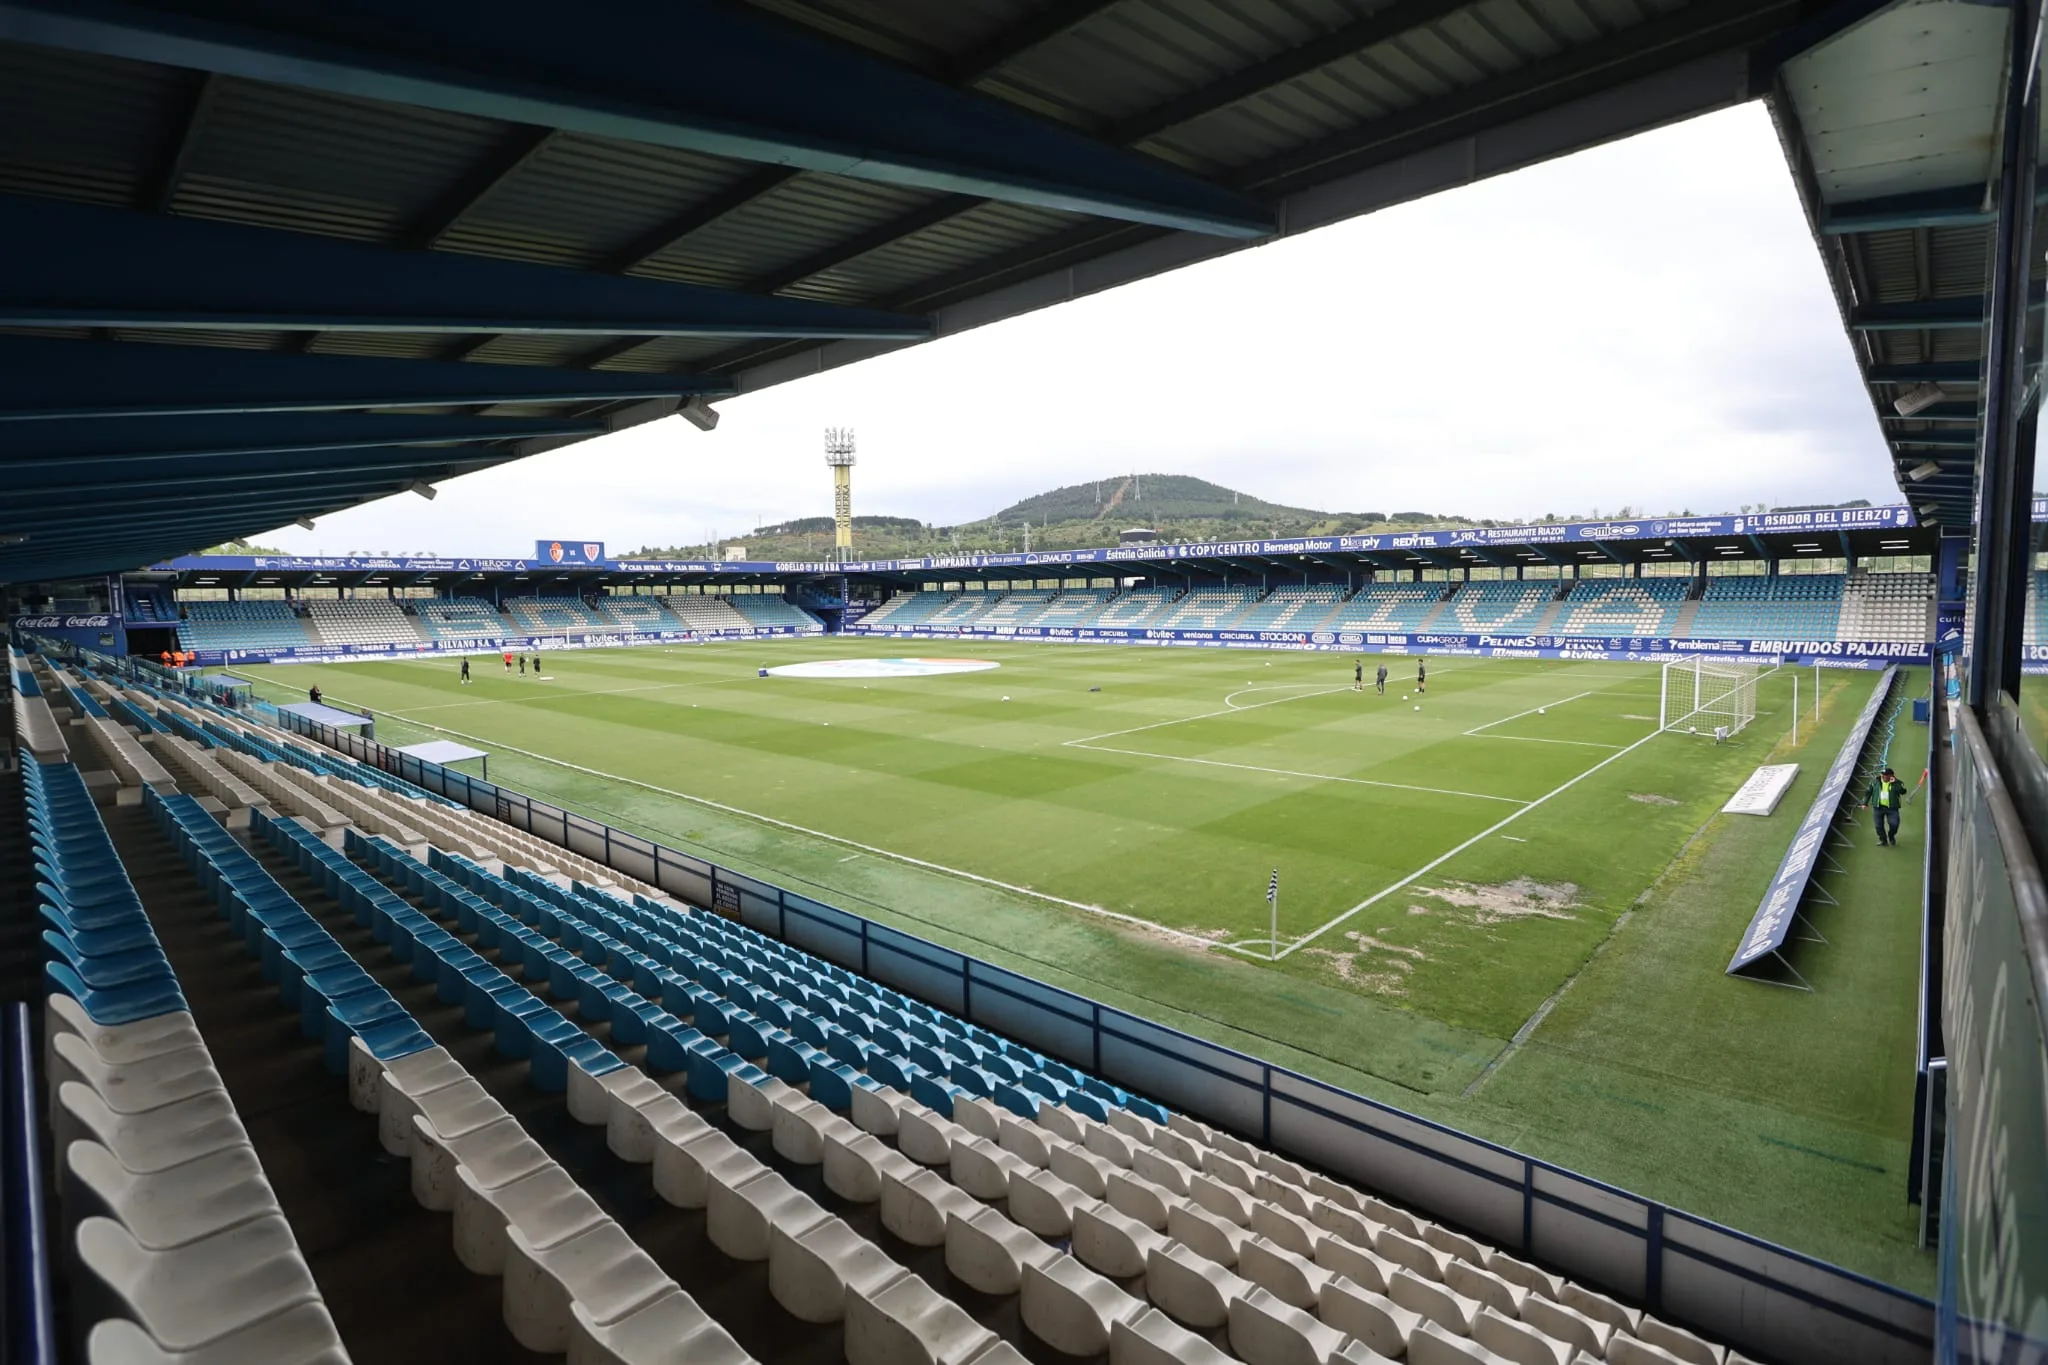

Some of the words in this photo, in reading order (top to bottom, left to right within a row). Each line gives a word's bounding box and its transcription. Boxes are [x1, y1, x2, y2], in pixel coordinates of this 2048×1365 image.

[1747, 516, 1760, 526] EL
[1764, 513, 1811, 526] ASADOR
[1815, 511, 1838, 524] DEL
[1841, 509, 1891, 522] BIERZO
[1488, 528, 1536, 538] RESTAURANTE
[1538, 527, 1566, 536] RIAZOR
[1305, 540, 1332, 550] Motor
[1393, 536, 1437, 547] REDYTEL
[1106, 549, 1136, 560] Estrella
[1137, 547, 1165, 559] Galicia
[1190, 543, 1260, 556] COPYCENTRO
[931, 557, 970, 568] XAMPRADA
[1039, 553, 1072, 563] LEMAUTO
[776, 563, 805, 572] GODELLO
[1054, 628, 1074, 636] tvitec
[1153, 630, 1175, 638] tvitec
[1220, 632, 1255, 640] CRICURSA
[1260, 632, 1306, 642] STOCBOND
[592, 634, 619, 643] tvitec
[1479, 635, 1537, 648] PELINES
[438, 639, 475, 649] SILVANO
[1677, 640, 1719, 650] emblema
[1749, 640, 1842, 655] EMBUTIDOS
[1846, 641, 1929, 657] PAJARIEL
[1572, 650, 1609, 660] tvitec
